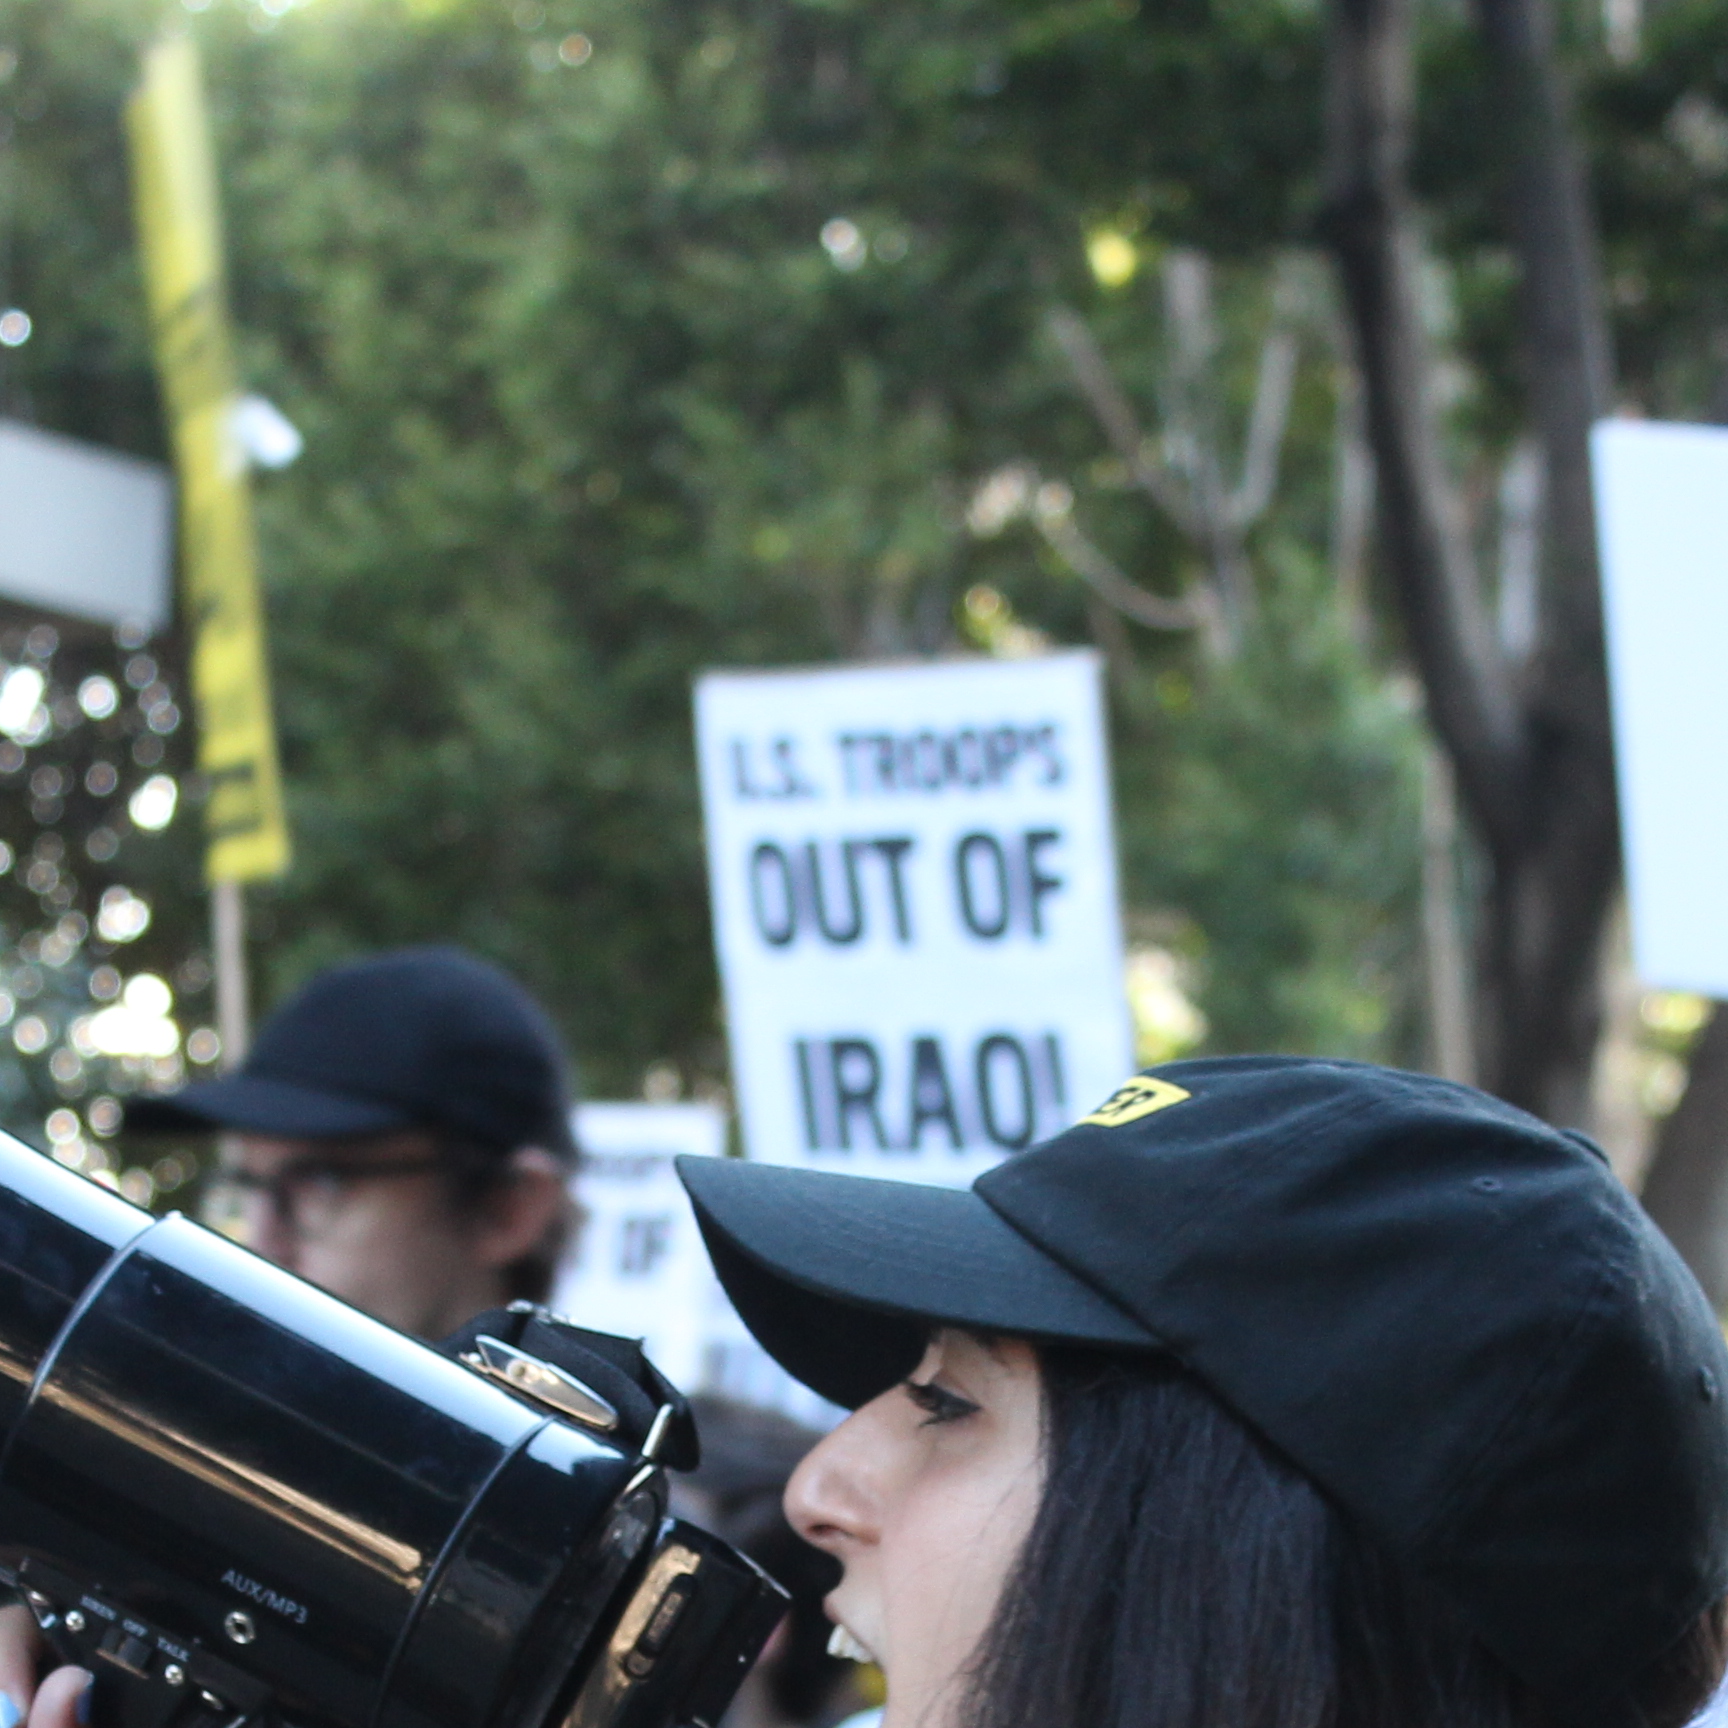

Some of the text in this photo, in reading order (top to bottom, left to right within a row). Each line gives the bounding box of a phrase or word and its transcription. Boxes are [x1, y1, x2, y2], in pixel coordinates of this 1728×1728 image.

[730, 722, 1063, 798] U.S. TROOPS
[749, 829, 1064, 948] OUT OF
[221, 1566, 309, 1625] AUX/MP3
